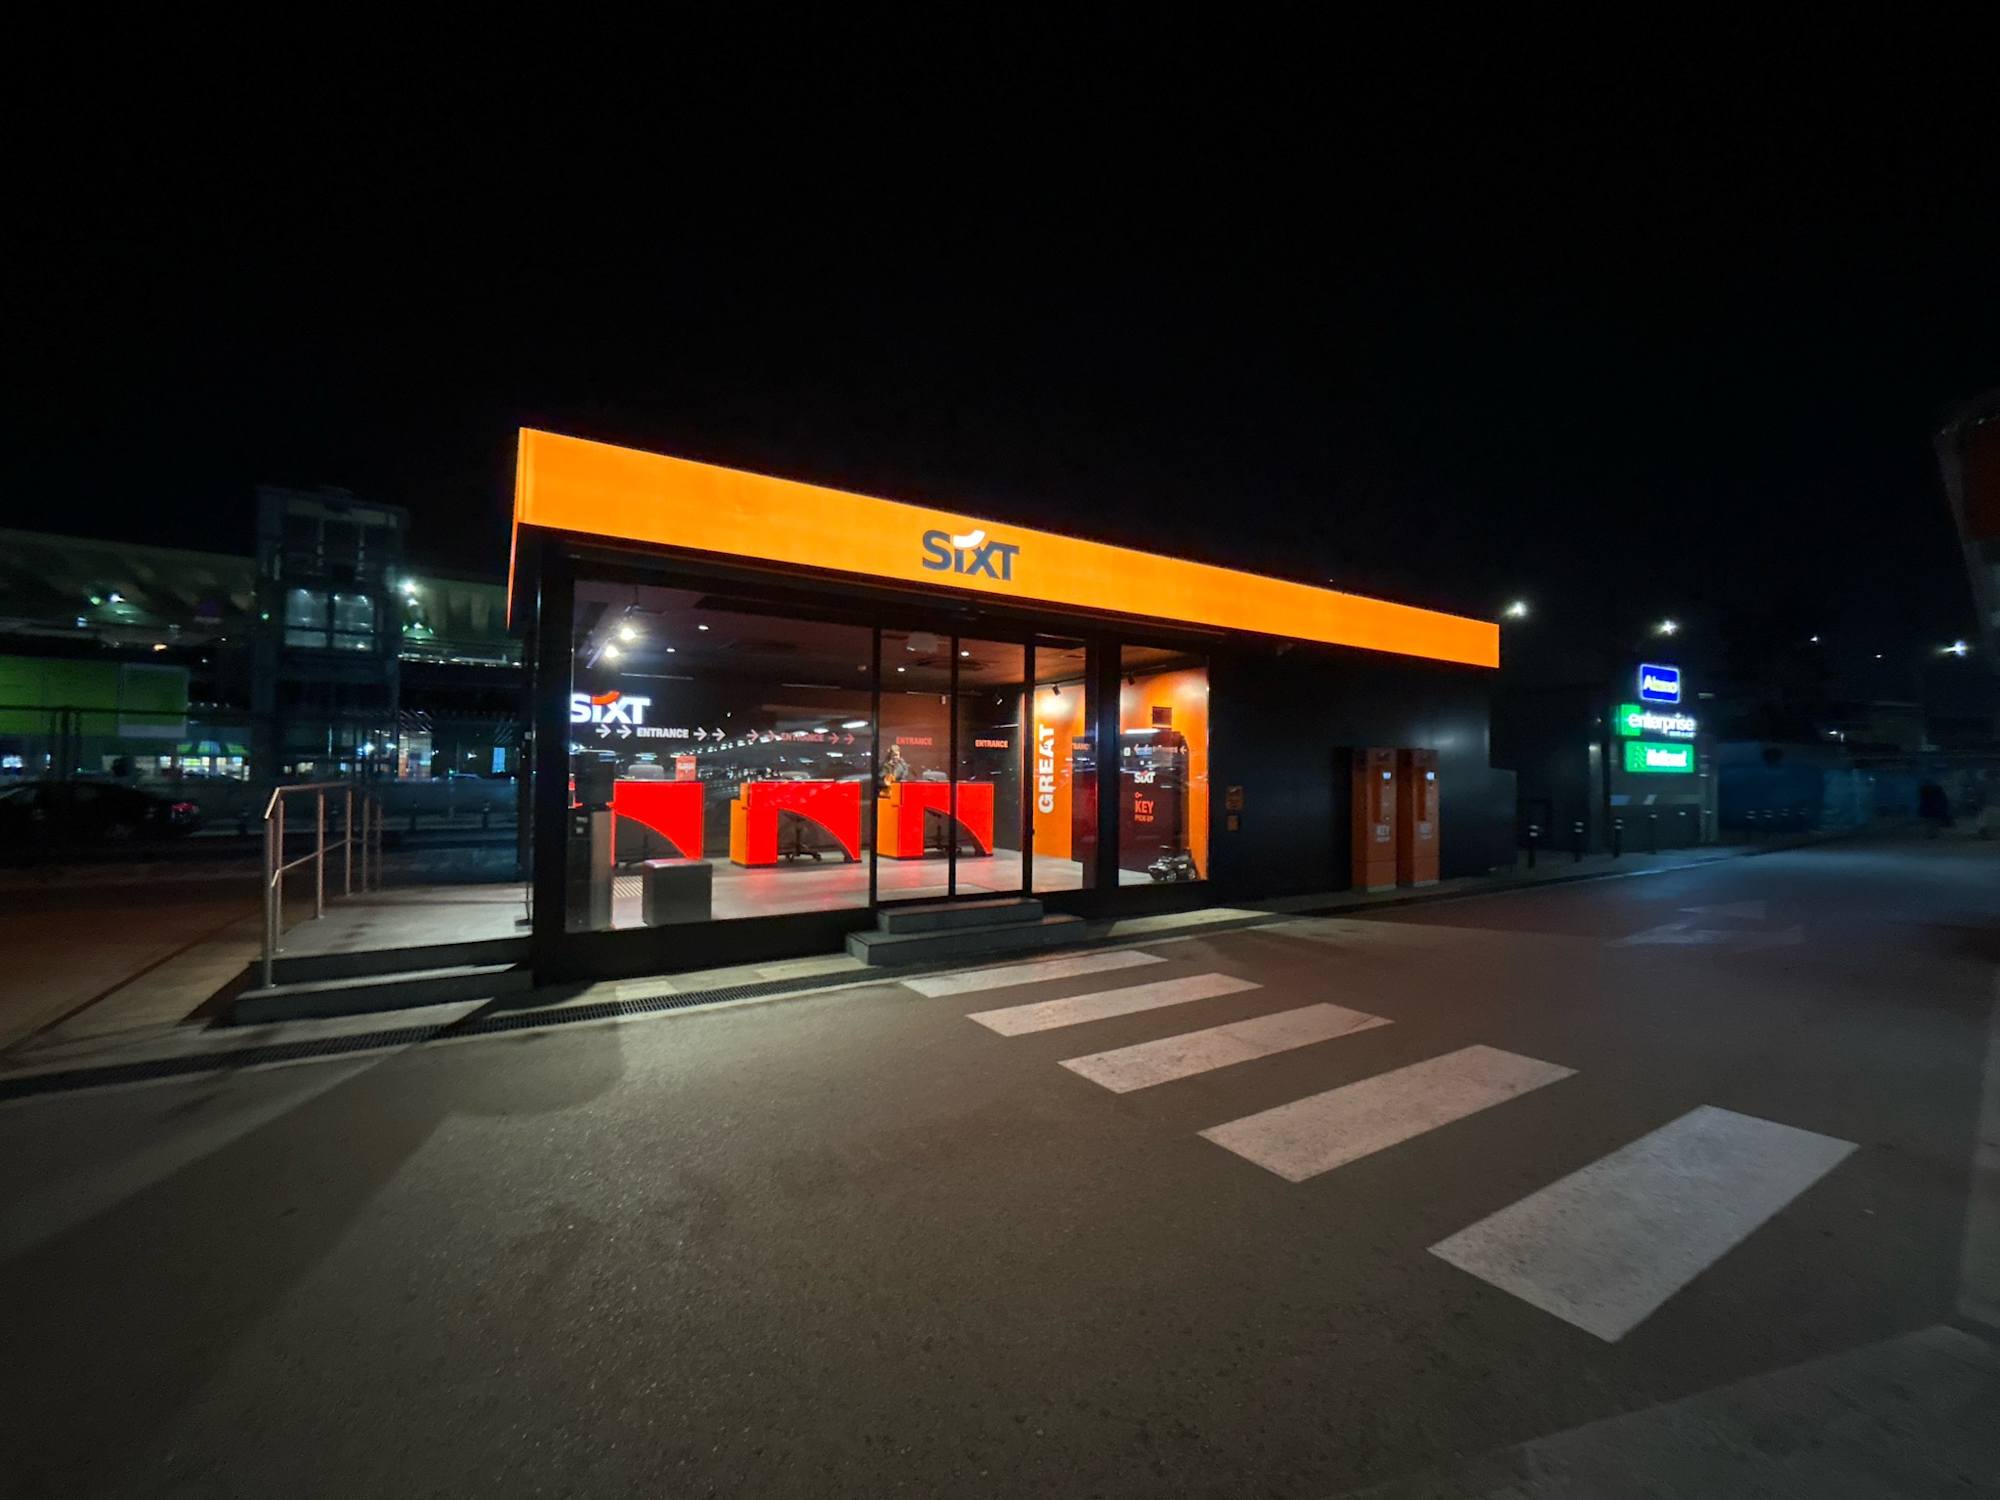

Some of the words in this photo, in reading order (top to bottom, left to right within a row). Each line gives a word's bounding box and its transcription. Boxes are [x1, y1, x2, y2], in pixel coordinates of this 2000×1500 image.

[922, 529, 1020, 581] SIXT
[570, 690, 652, 724] SIXT
[1628, 711, 1696, 734] enterprise
[636, 727, 689, 739] ENTRANCE
[896, 736, 933, 746] ENTRANCE
[975, 739, 1009, 748] ENTRANCE
[1038, 724, 1056, 814] GREAT
[1134, 771, 1156, 784] SIXT
[1135, 801, 1154, 814] KEY
